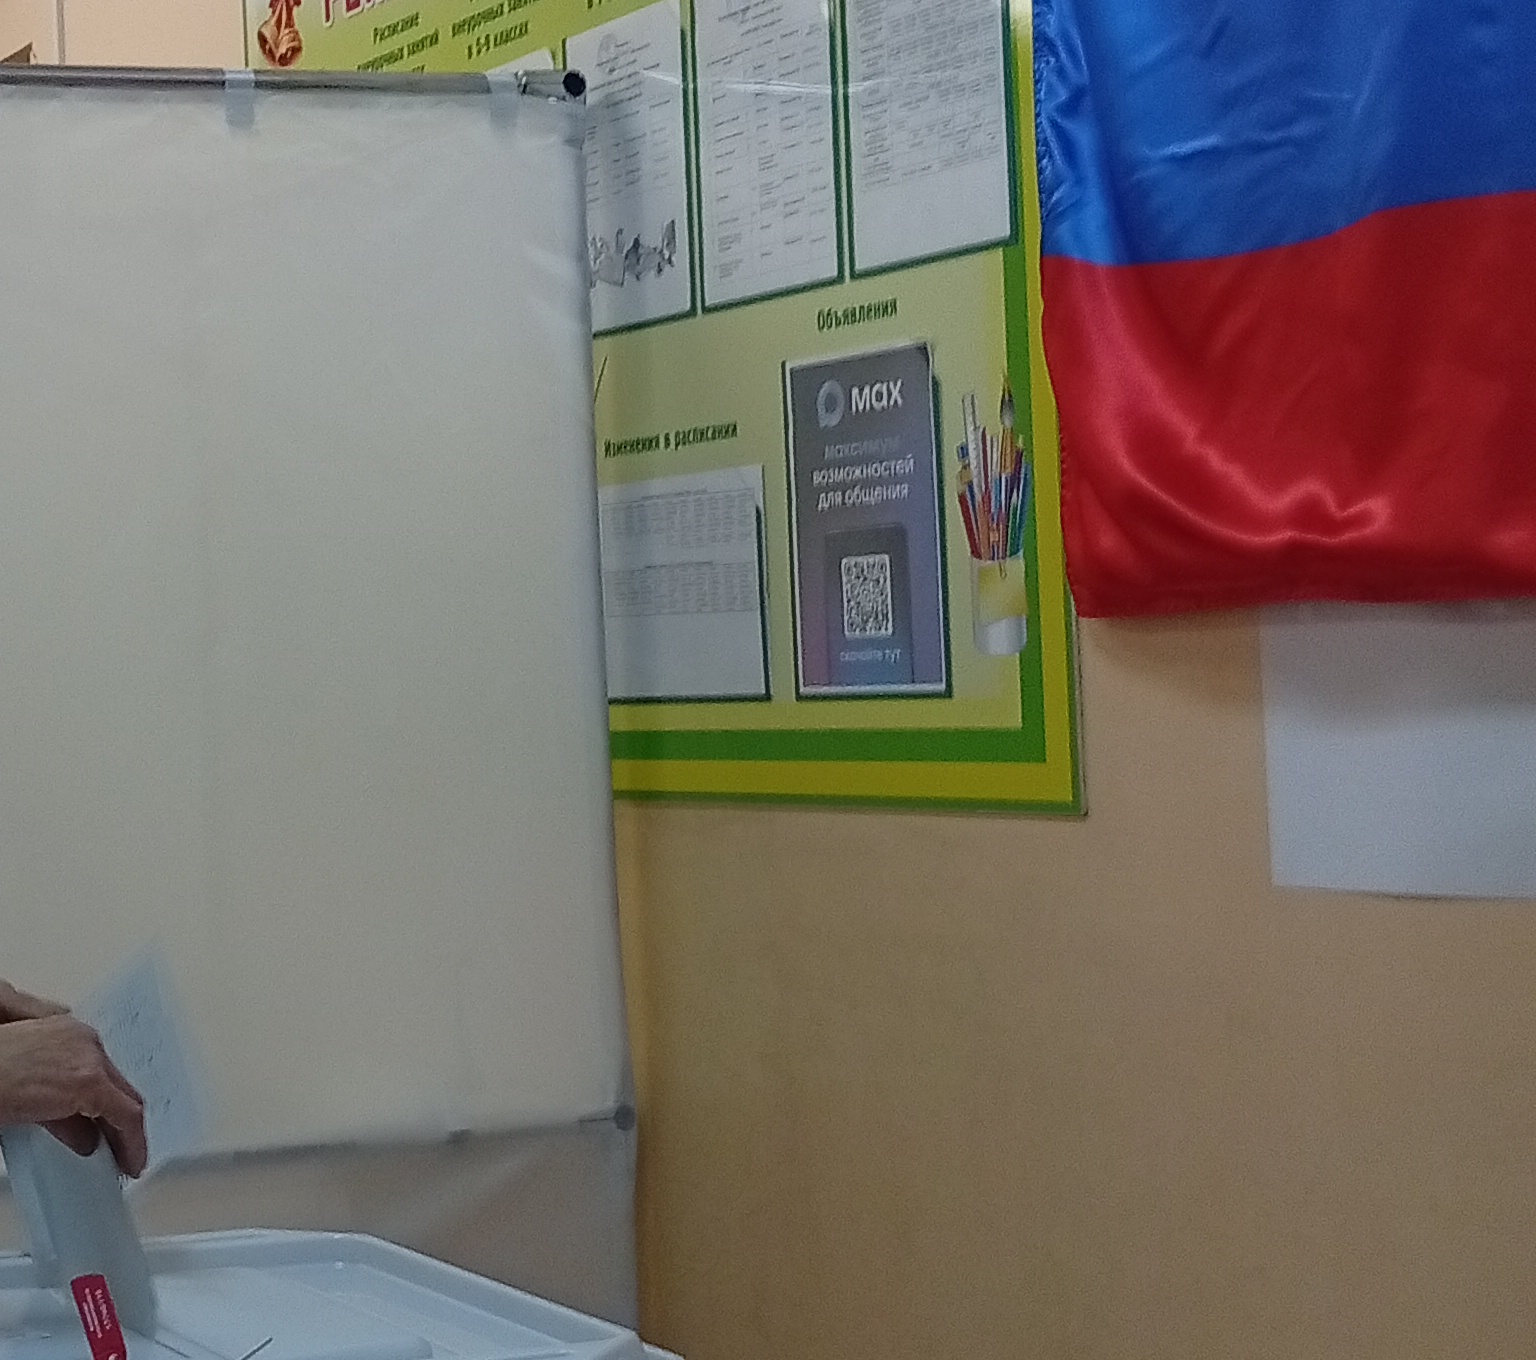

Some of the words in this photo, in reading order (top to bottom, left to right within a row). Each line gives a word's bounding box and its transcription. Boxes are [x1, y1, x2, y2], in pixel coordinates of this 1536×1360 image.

[817, 296, 899, 332] Объявления
[812, 453, 915, 487] возможностей
[817, 492, 843, 513] для
[843, 483, 910, 509] общения
